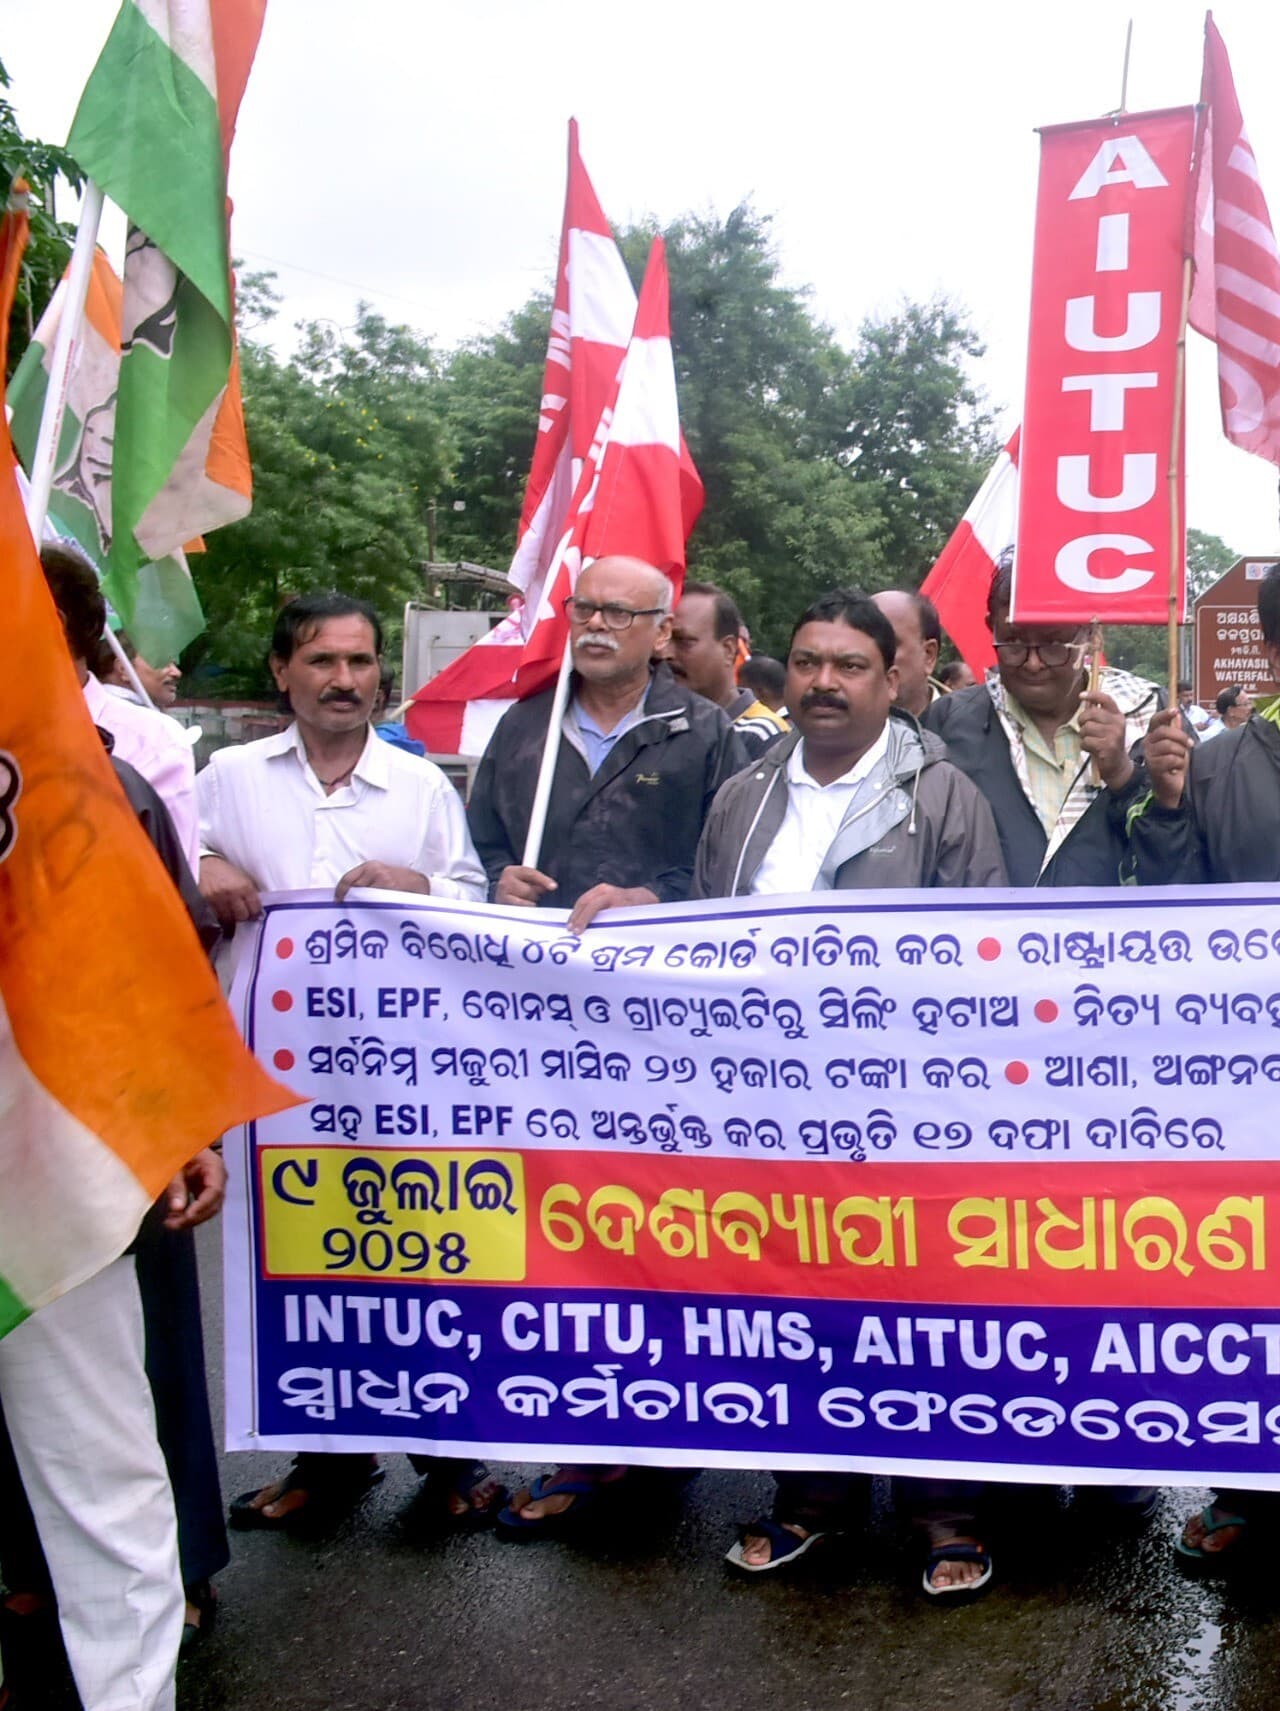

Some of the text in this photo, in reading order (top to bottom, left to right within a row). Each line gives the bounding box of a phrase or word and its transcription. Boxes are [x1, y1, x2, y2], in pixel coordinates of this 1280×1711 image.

[1054, 135, 1169, 593] AIUTUC
[1215, 671, 1274, 682] WATERFAL
[305, 918, 389, 965] ଶ୍ରମିକ
[770, 924, 881, 968] ବାତିଲ
[895, 934, 963, 967] କର
[306, 986, 364, 1021] ESI,
[377, 987, 448, 1021] EPF,
[462, 990, 579, 1032] ବୋନସ୍
[583, 995, 611, 1023] ଓ
[912, 996, 1019, 1036] ହଟାଅ
[1073, 983, 1160, 1027] ନିତ୍ୟ
[430, 1047, 528, 1087] ମଜୁରୀ
[540, 1040, 631, 1081] ମାସିକ
[644, 1055, 697, 1083] ୨୬
[710, 1056, 812, 1094] ହଜାର
[922, 1056, 992, 1090] କର
[310, 1104, 362, 1141] ସହ
[375, 1104, 438, 1138] ESI,
[452, 1104, 513, 1136] EPF
[526, 1108, 581, 1141] ରେ
[723, 1117, 786, 1151] କର
[913, 1121, 973, 1150] ୧୭
[1086, 1106, 1226, 1151] ଦାବିରେ
[273, 1158, 515, 1224] ୯ ଜୁଲାଇ
[324, 1230, 468, 1273] ୨୦୨୫
[541, 1184, 918, 1266] ଦେଶବ୍ୟାପୀ
[949, 1197, 1266, 1276] ସାଧାରଣ
[285, 1295, 481, 1360] INTUC,
[502, 1302, 662, 1366] CITU,
[683, 1307, 832, 1373] HMS,
[853, 1316, 1068, 1384] AITUC,
[498, 1364, 788, 1427] କର୍ମଚାରୀ
